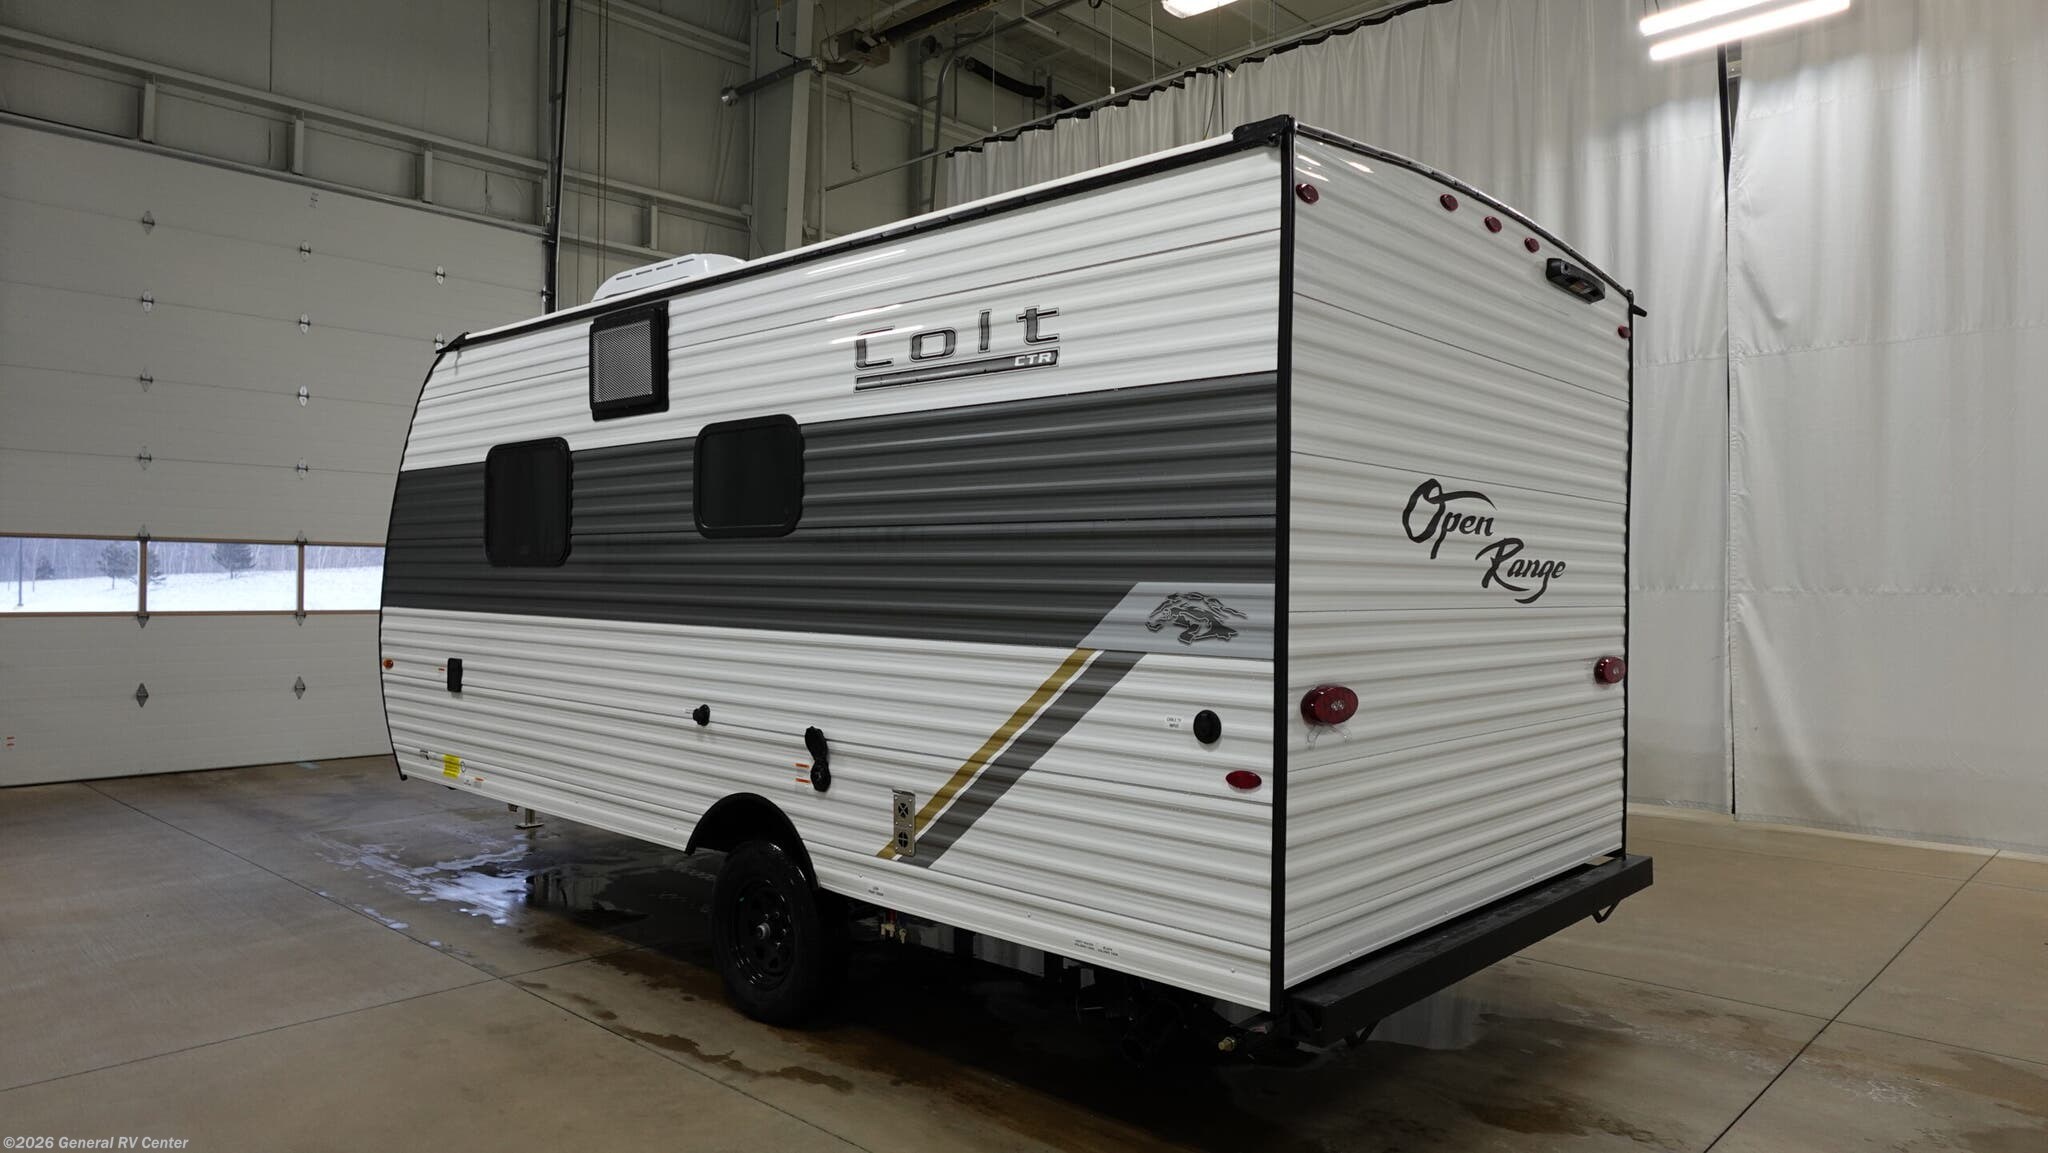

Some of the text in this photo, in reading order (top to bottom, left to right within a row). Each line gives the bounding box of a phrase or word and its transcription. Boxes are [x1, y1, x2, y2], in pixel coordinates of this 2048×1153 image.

[855, 305, 1060, 370] Colt
[1013, 352, 1053, 367] CTR
[1402, 478, 1497, 560] Open
[1475, 537, 1567, 604] Range
